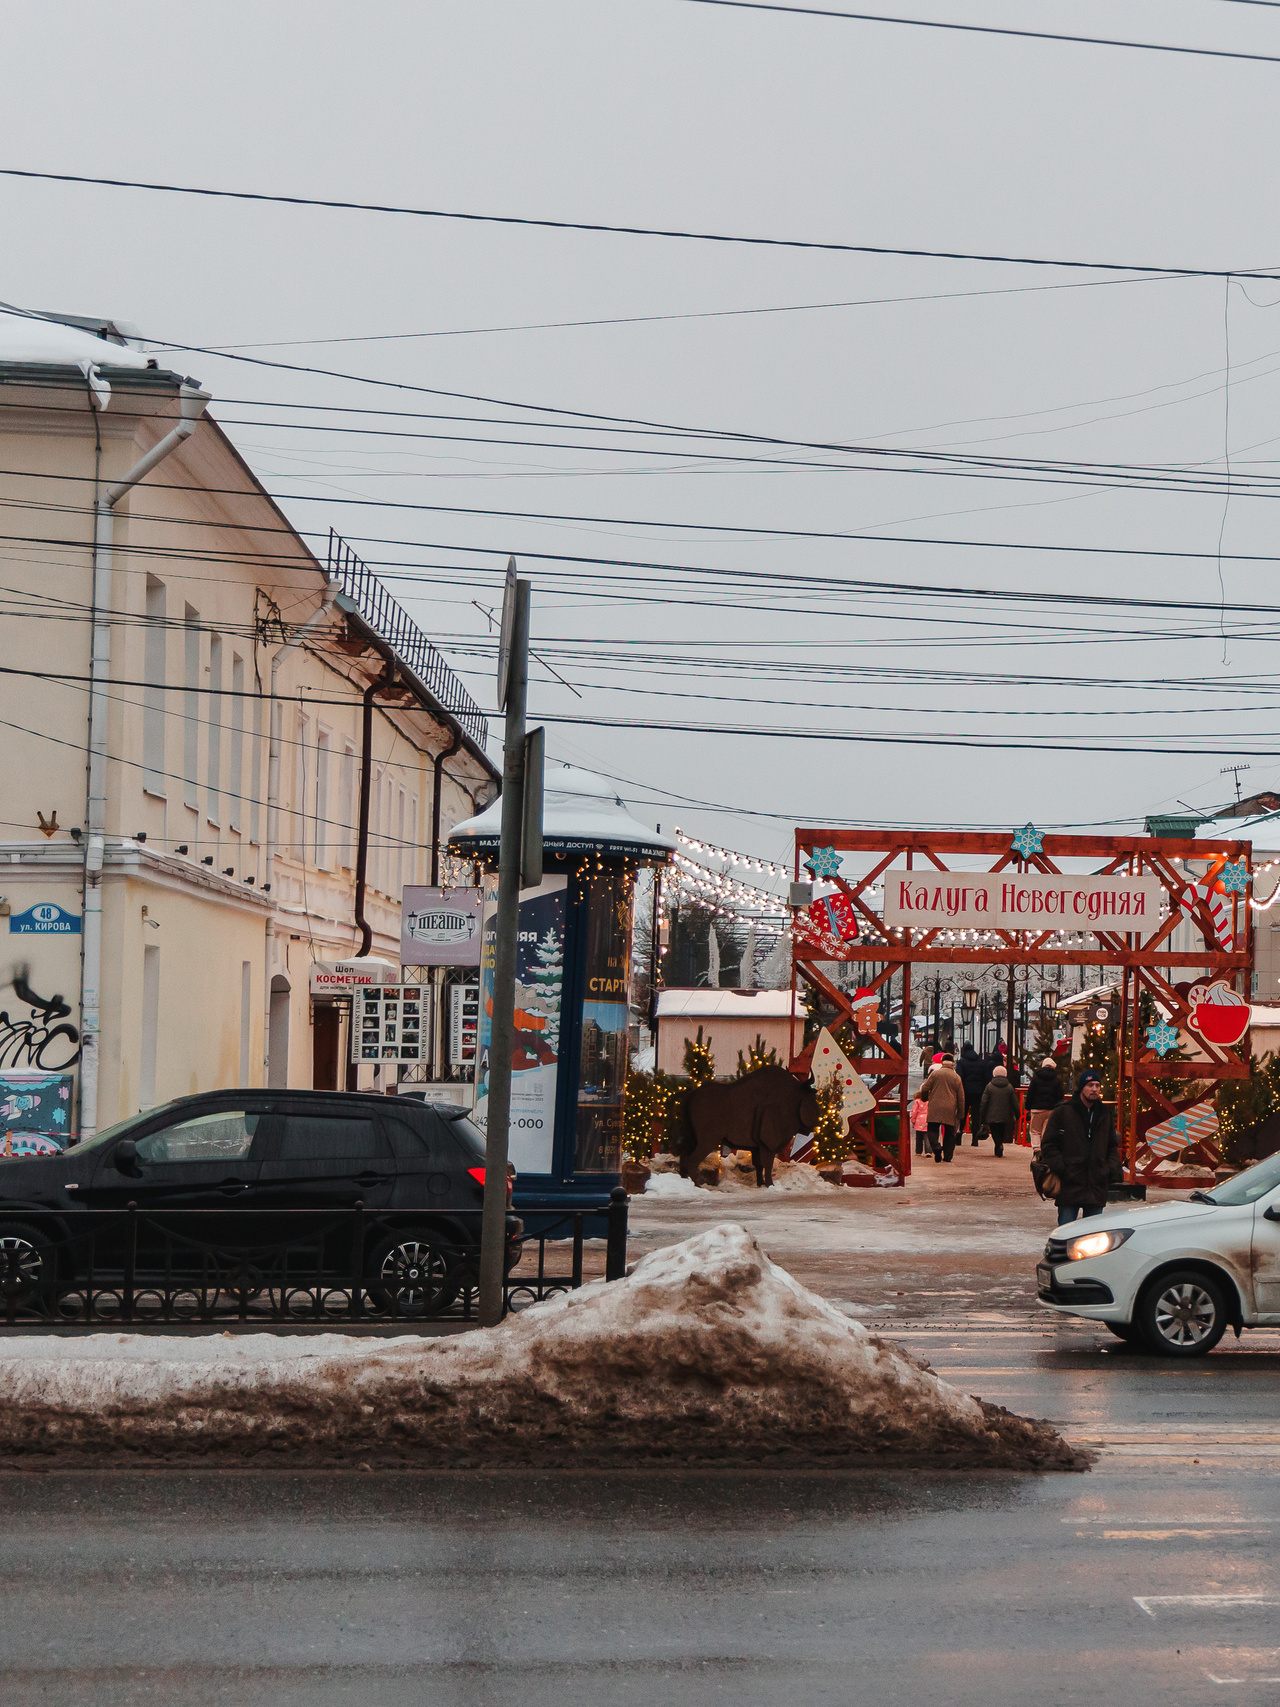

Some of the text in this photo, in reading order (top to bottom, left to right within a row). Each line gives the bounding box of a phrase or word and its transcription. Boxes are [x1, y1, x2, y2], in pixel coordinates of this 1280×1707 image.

[900, 881, 1146, 920] Калуга Новогодняя
[40, 908, 52, 920] 48
[20, 922, 71, 931] ул. КИРОВА
[316, 975, 372, 984] КОСМЕТИК
